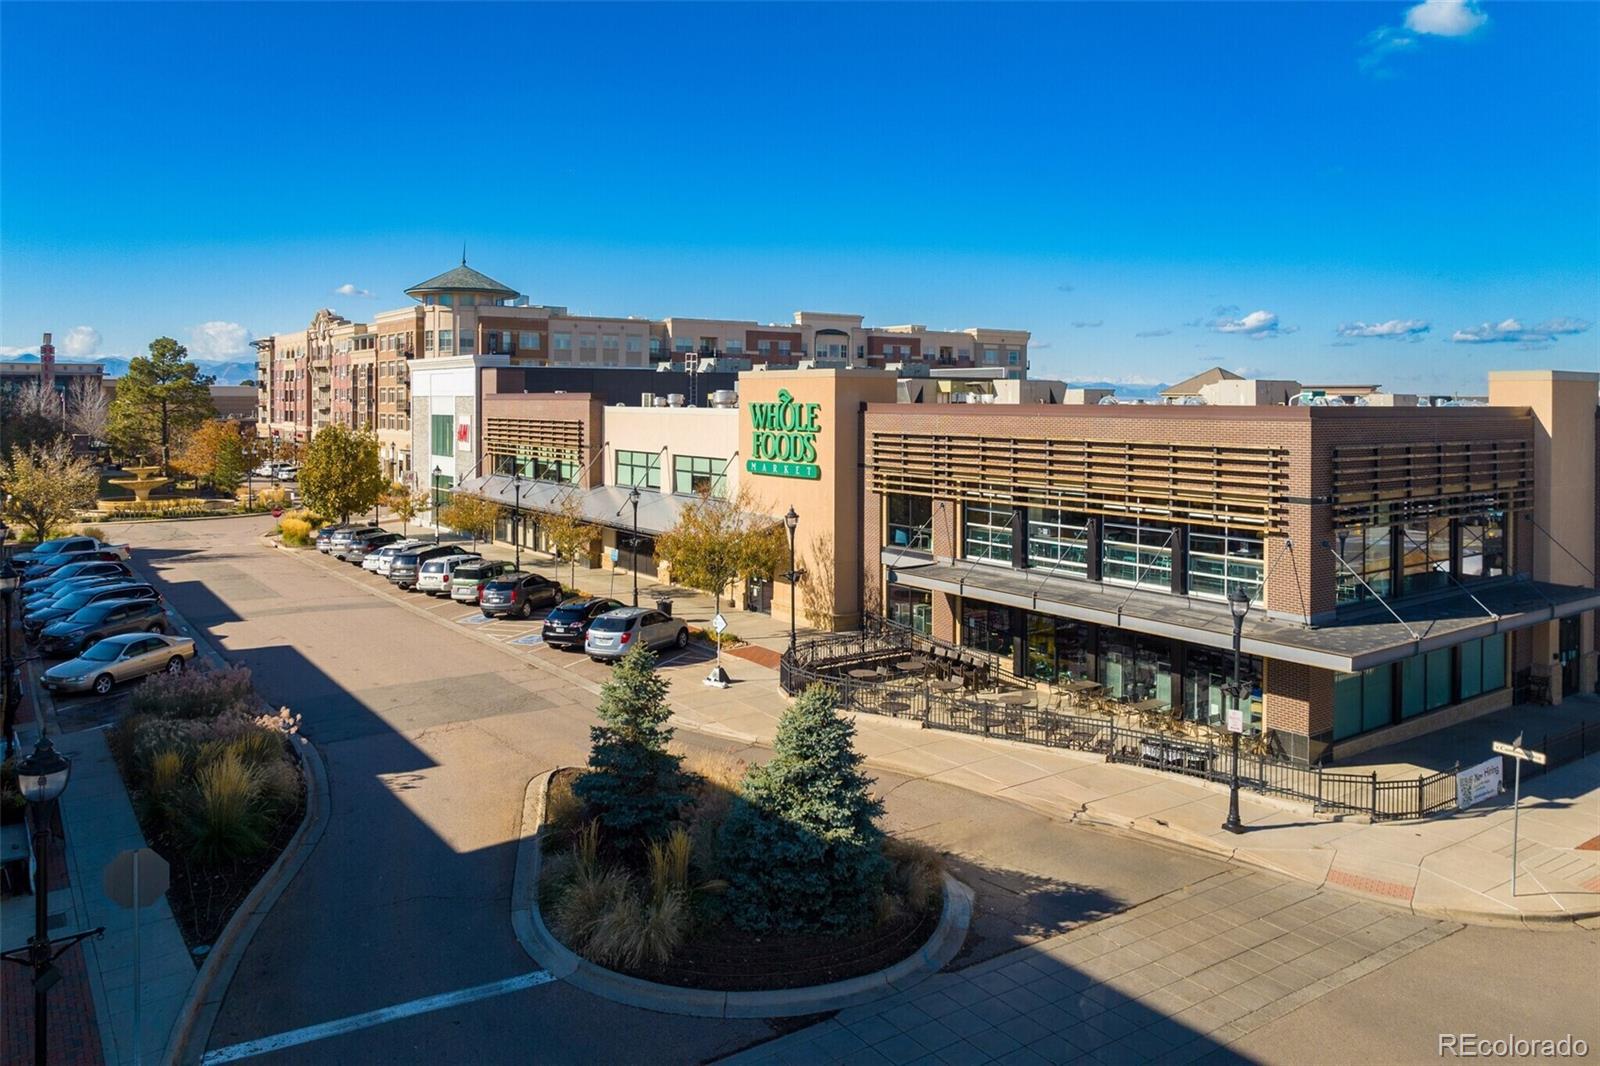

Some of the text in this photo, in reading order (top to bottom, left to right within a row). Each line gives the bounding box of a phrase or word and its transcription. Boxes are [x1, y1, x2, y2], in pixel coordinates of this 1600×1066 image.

[748, 402, 821, 432] WHOLE
[752, 431, 817, 463] FOODS
[750, 462, 811, 476] MARKET
